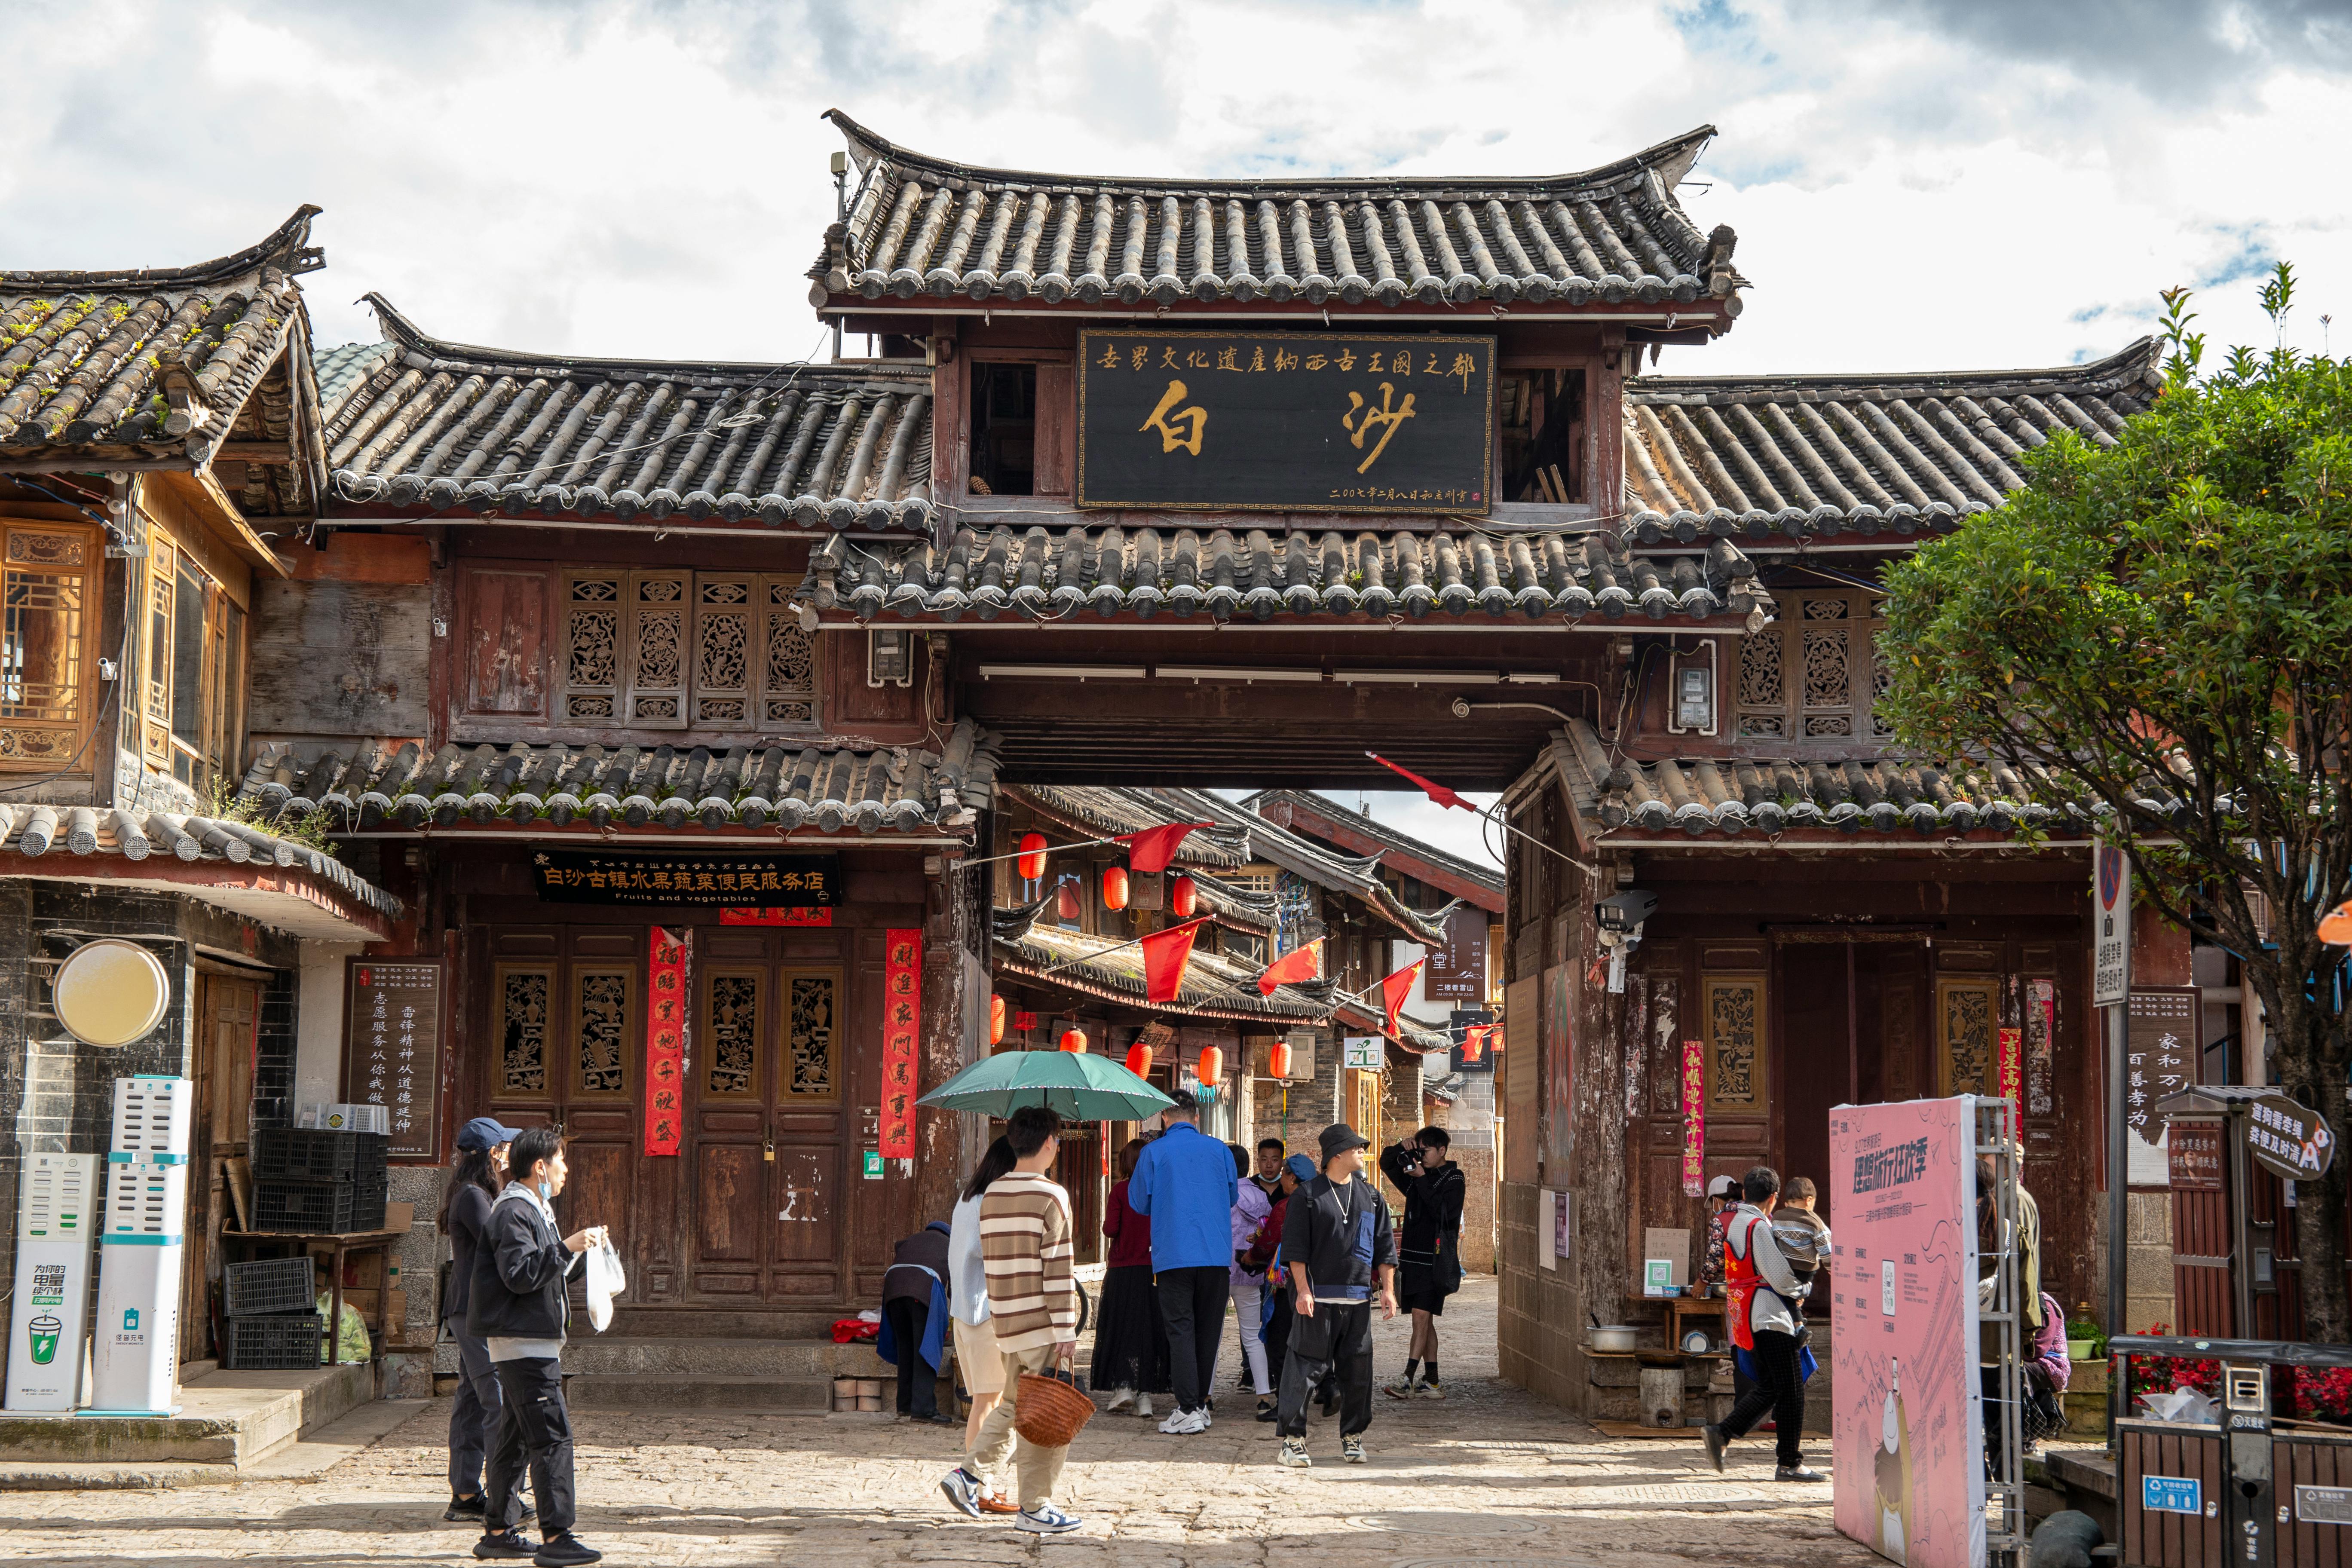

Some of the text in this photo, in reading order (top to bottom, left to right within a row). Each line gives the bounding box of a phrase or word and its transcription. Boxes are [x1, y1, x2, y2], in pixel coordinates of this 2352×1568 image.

[1139, 380, 1415, 474] 白沙
[544, 867, 824, 891] 白沙古镇水果蔬菜便民服务店
[687, 894, 756, 903] vegetables
[1432, 952, 1447, 969] 堂
[395, 1006, 416, 1133] 雷锋精神从道德延伸
[2158, 1033, 2181, 1126] 家和万
[2251, 1102, 2303, 1140] 遛狗需牵绳
[2249, 1125, 2300, 1164] 粪便及时清
[1853, 1136, 1928, 1194] 理想旅行狂欢季
[33, 1274, 64, 1286] 电量
[34, 1265, 66, 1273] 为你的
[32, 1286, 64, 1295] 续个杯
